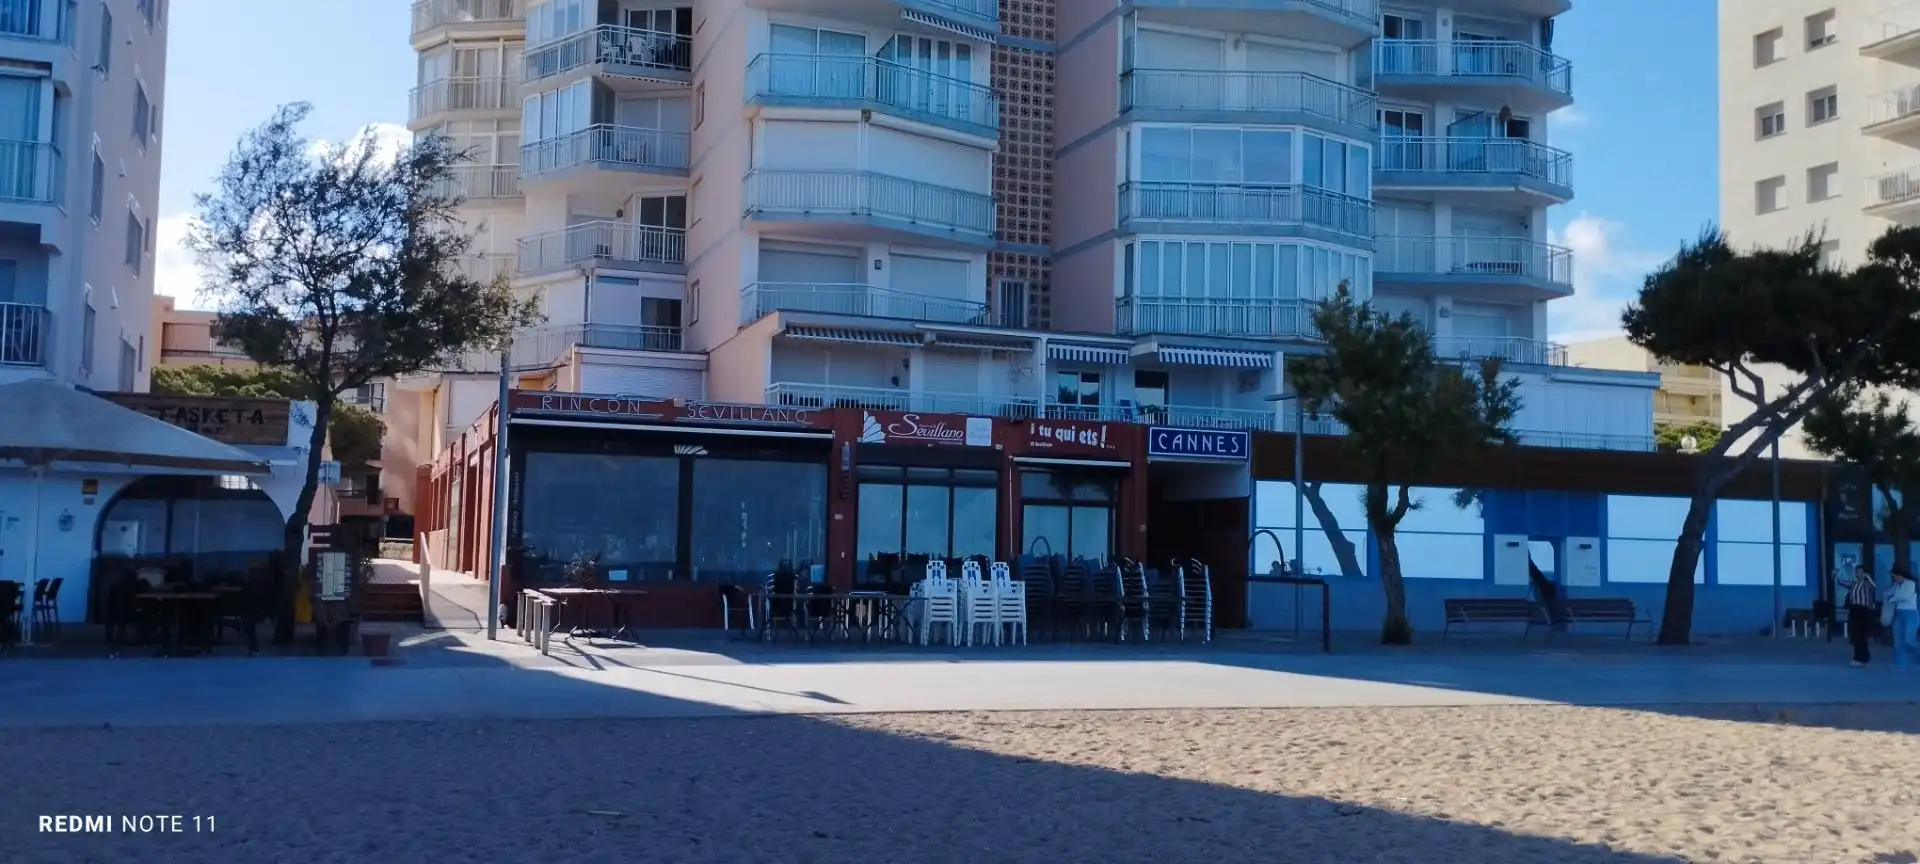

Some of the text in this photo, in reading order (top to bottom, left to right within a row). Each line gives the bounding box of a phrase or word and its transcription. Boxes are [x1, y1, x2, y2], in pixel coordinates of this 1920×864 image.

[687, 403, 808, 423] SEVILLANO
[887, 413, 964, 439] Sevillano
[1038, 424, 1052, 438] tu
[1055, 425, 1076, 442] qui
[1157, 432, 1241, 454] CANNES
